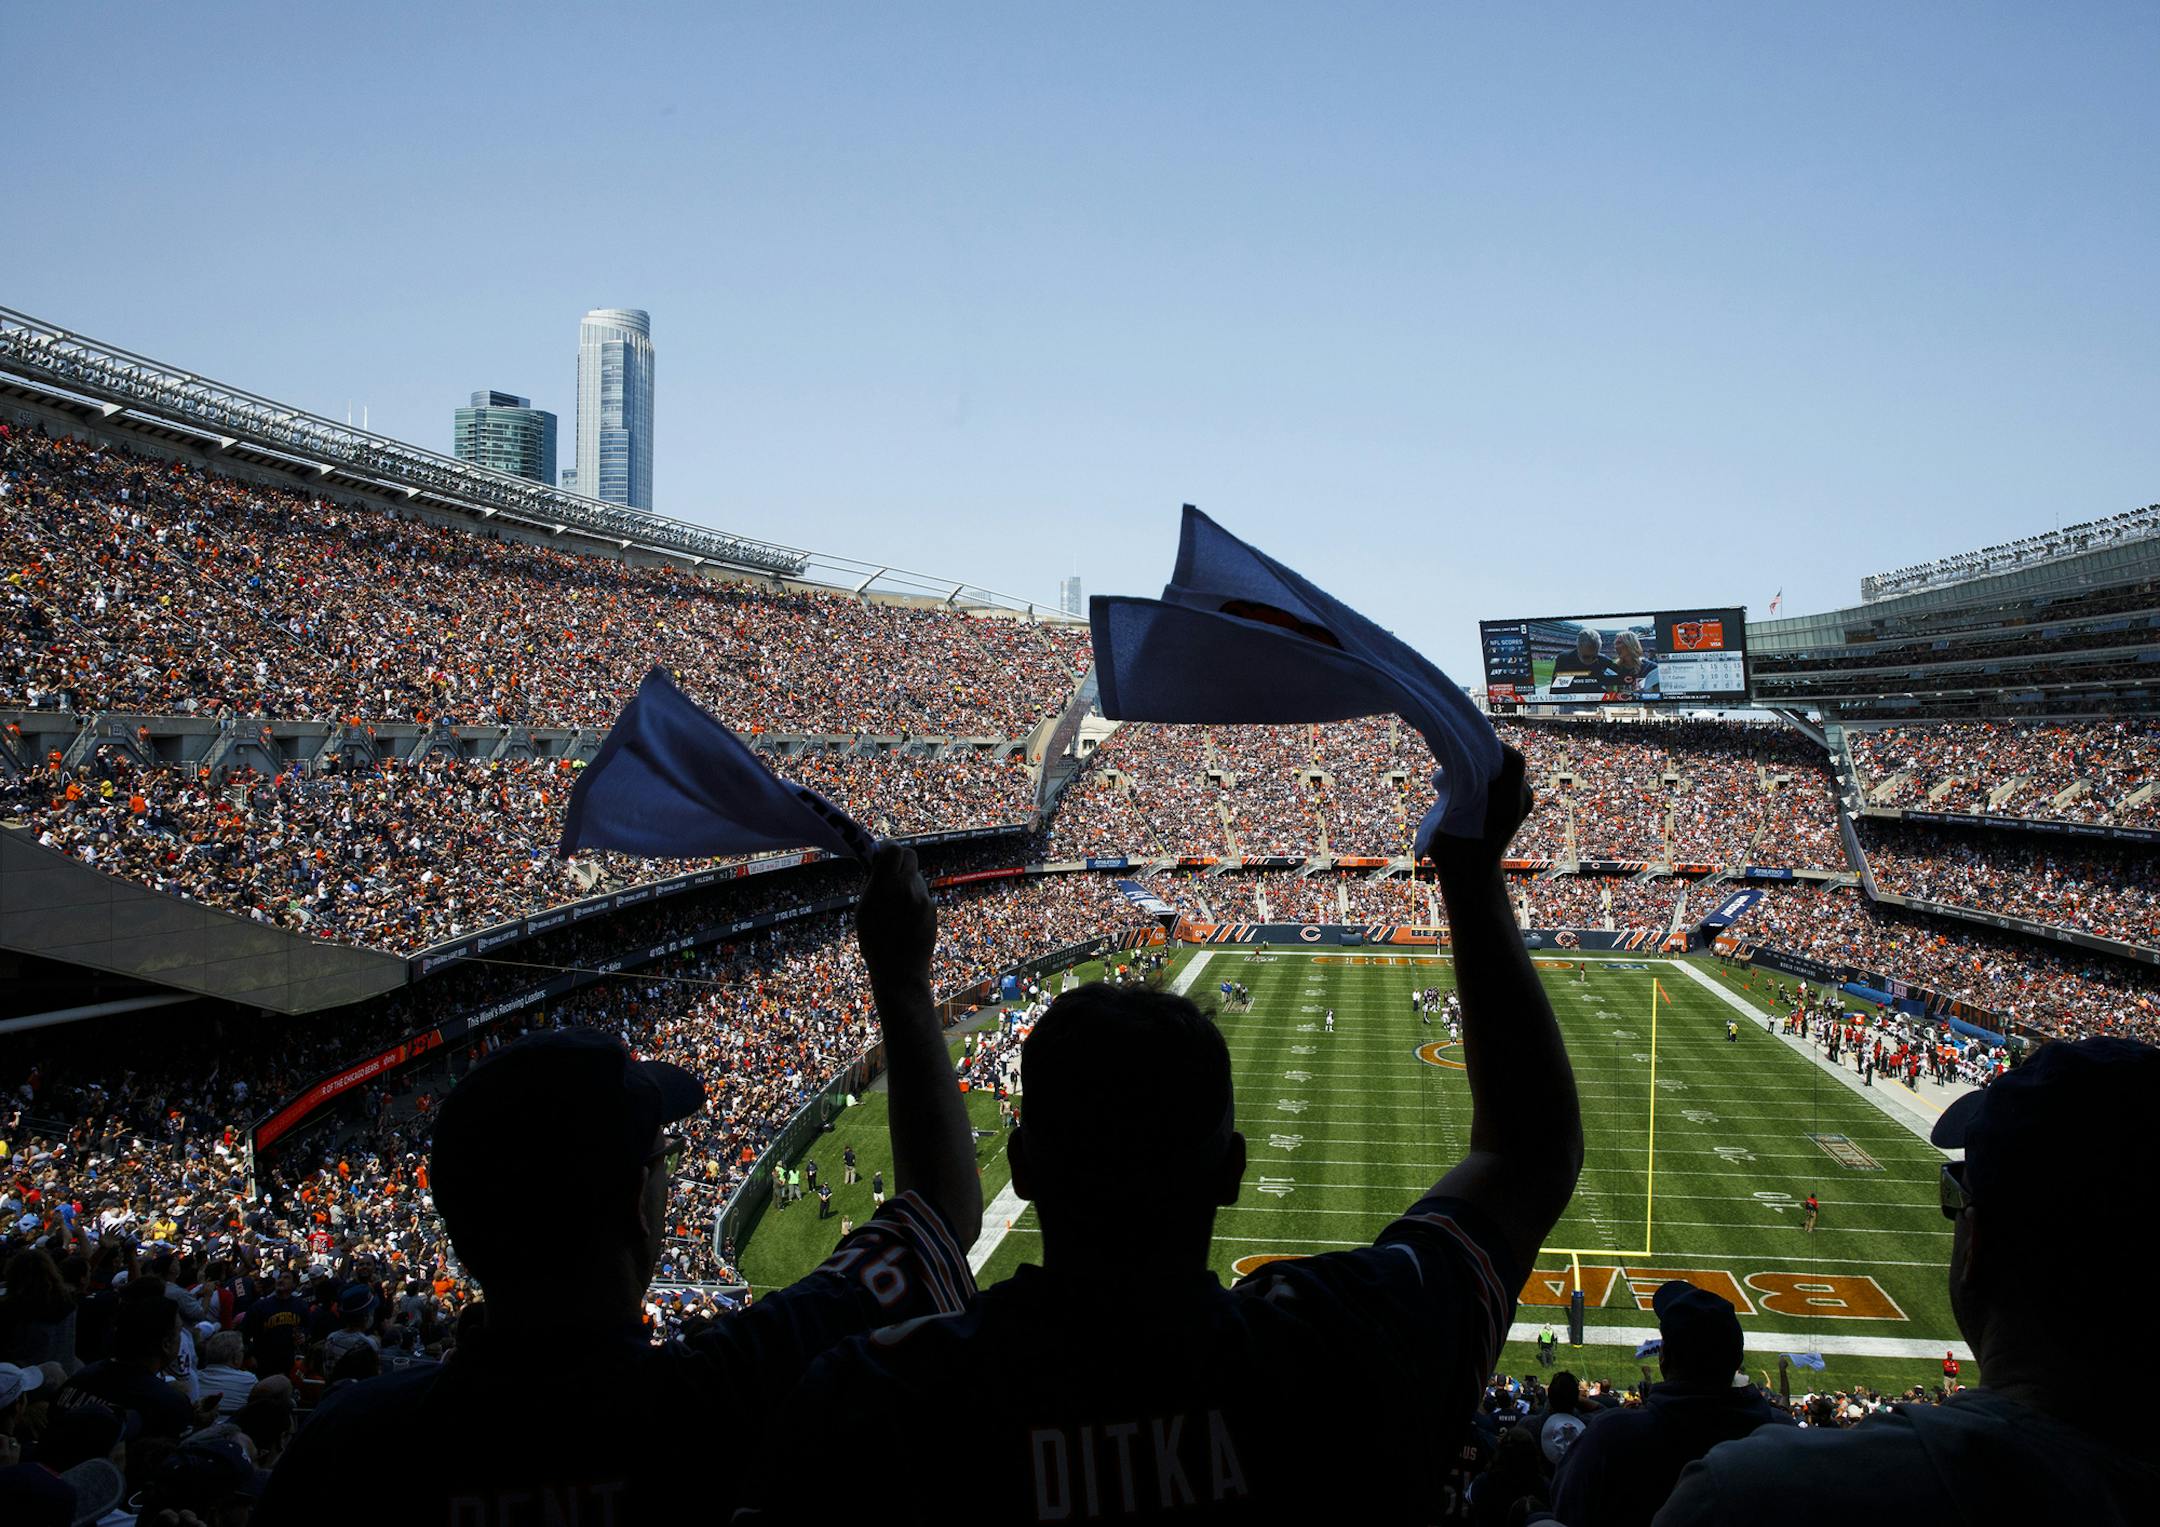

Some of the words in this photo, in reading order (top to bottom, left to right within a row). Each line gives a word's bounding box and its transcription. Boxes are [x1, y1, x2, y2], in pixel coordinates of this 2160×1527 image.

[694, 875, 714, 884] FALCONS
[1780, 962, 1792, 970] WORLD
[1794, 966, 1816, 977] CHAMPIONS
[467, 1014, 479, 1029] This
[480, 1009, 498, 1023] Week's
[498, 998, 524, 1015] Receiving
[327, 1083, 333, 1093] OF
[334, 1078, 343, 1089] THE
[344, 1069, 364, 1085] CHICAGO
[365, 1061, 380, 1074] BEARS
[384, 1054, 396, 1065] xfinity
[1258, 1175, 1295, 1193] 10
[1753, 1191, 1800, 1208] 10
[264, 1311, 301, 1329] MICHIGAN
[1031, 1408, 1249, 1520] DITKA
